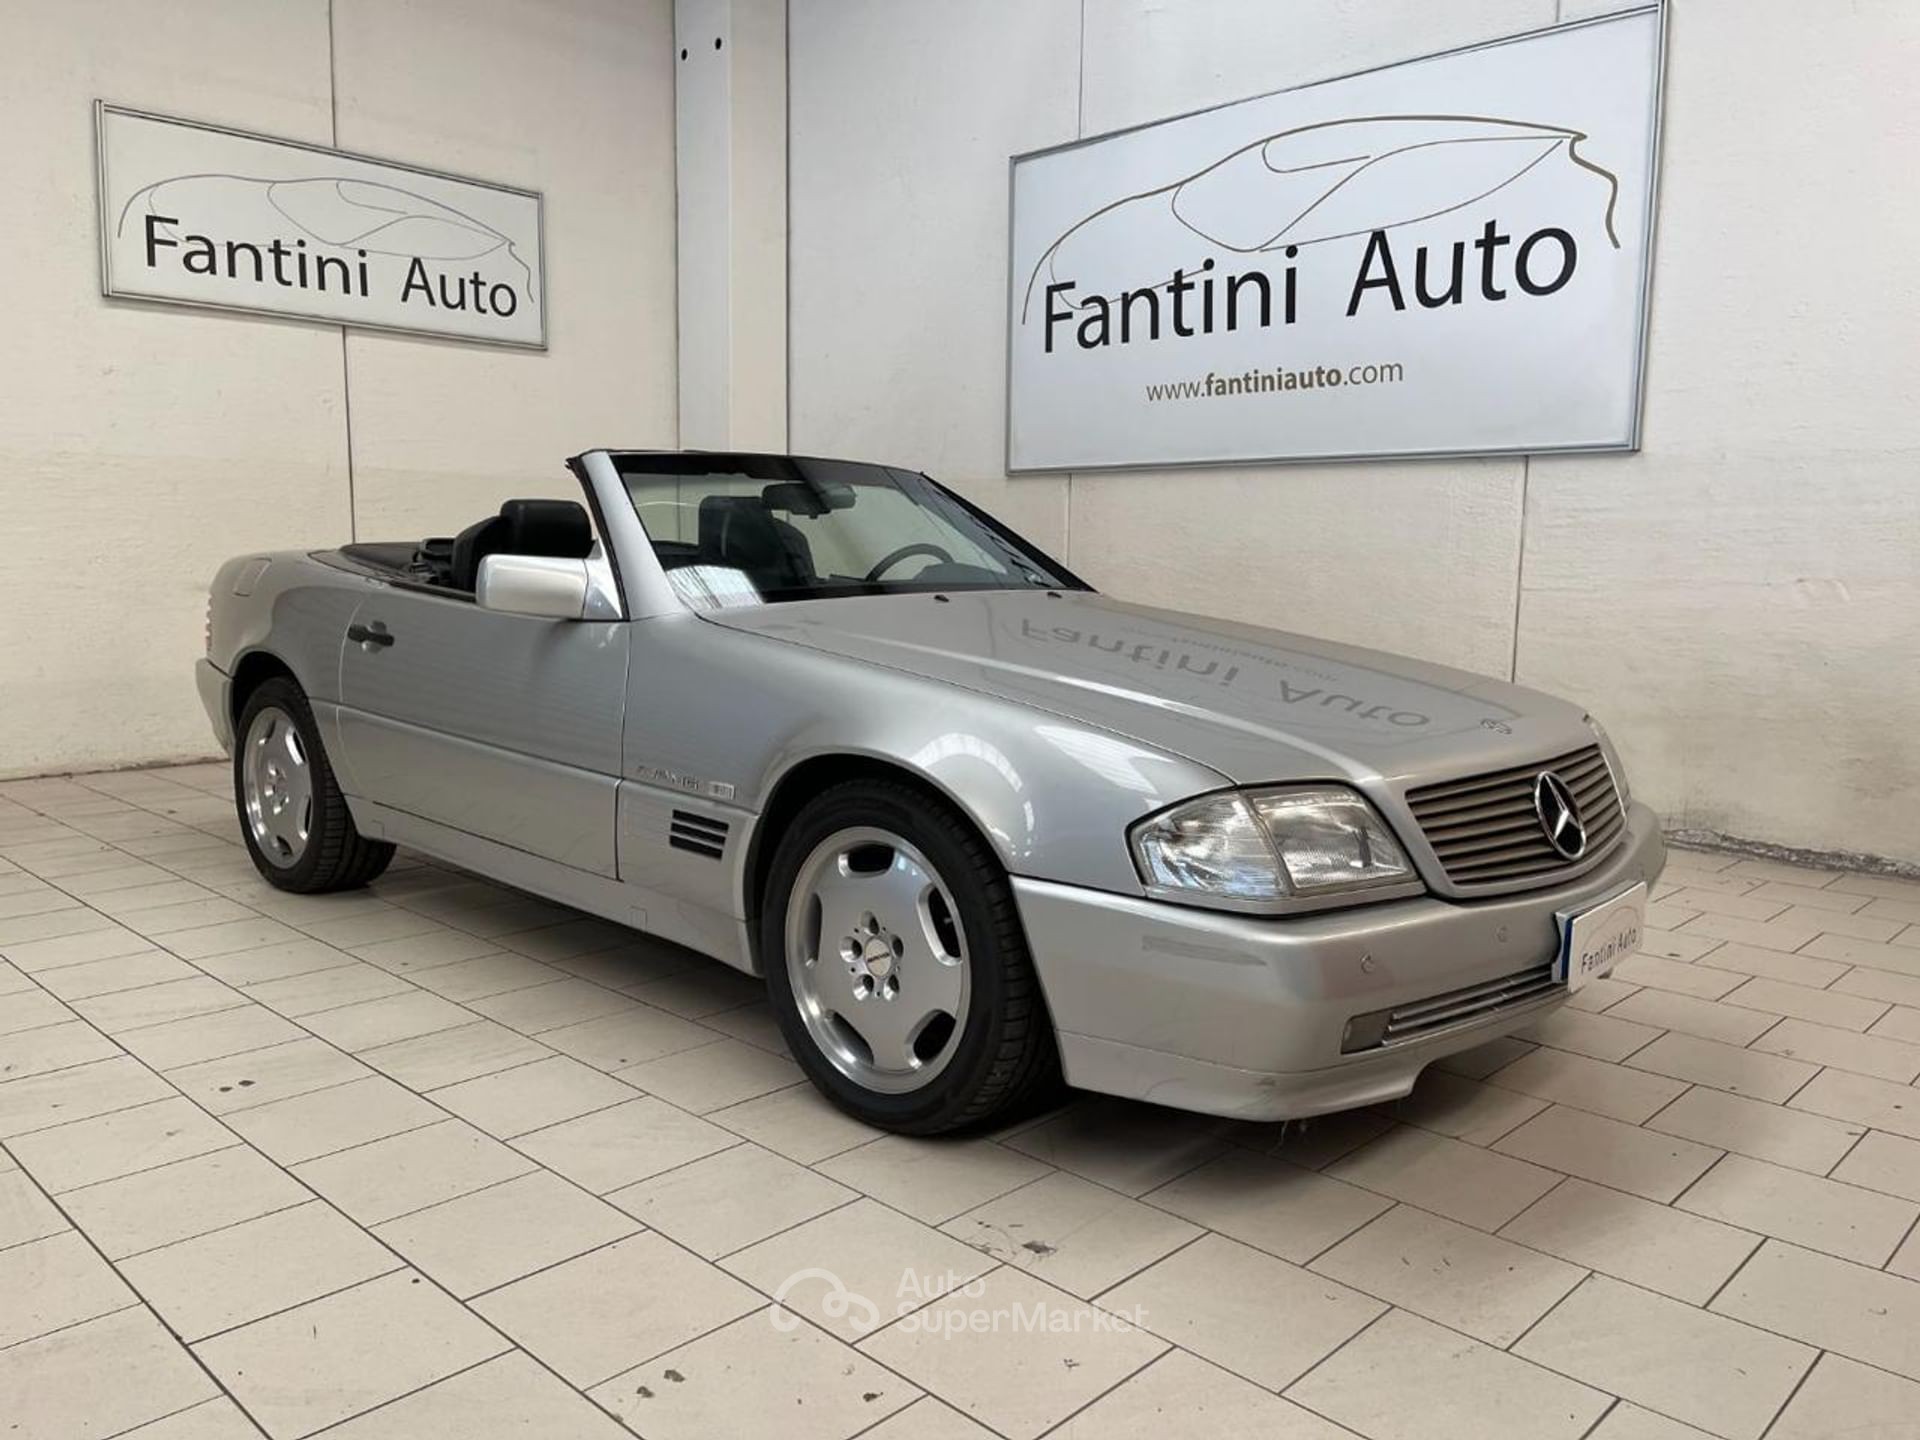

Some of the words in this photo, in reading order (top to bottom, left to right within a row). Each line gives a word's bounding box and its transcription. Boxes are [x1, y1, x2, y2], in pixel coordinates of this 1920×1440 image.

[144, 214, 369, 297] Fantini
[400, 256, 518, 317] Auto
[1044, 245, 1298, 353] Fantini
[1346, 219, 1577, 317] Auto
[1146, 360, 1404, 401] www.fantiniauto.com
